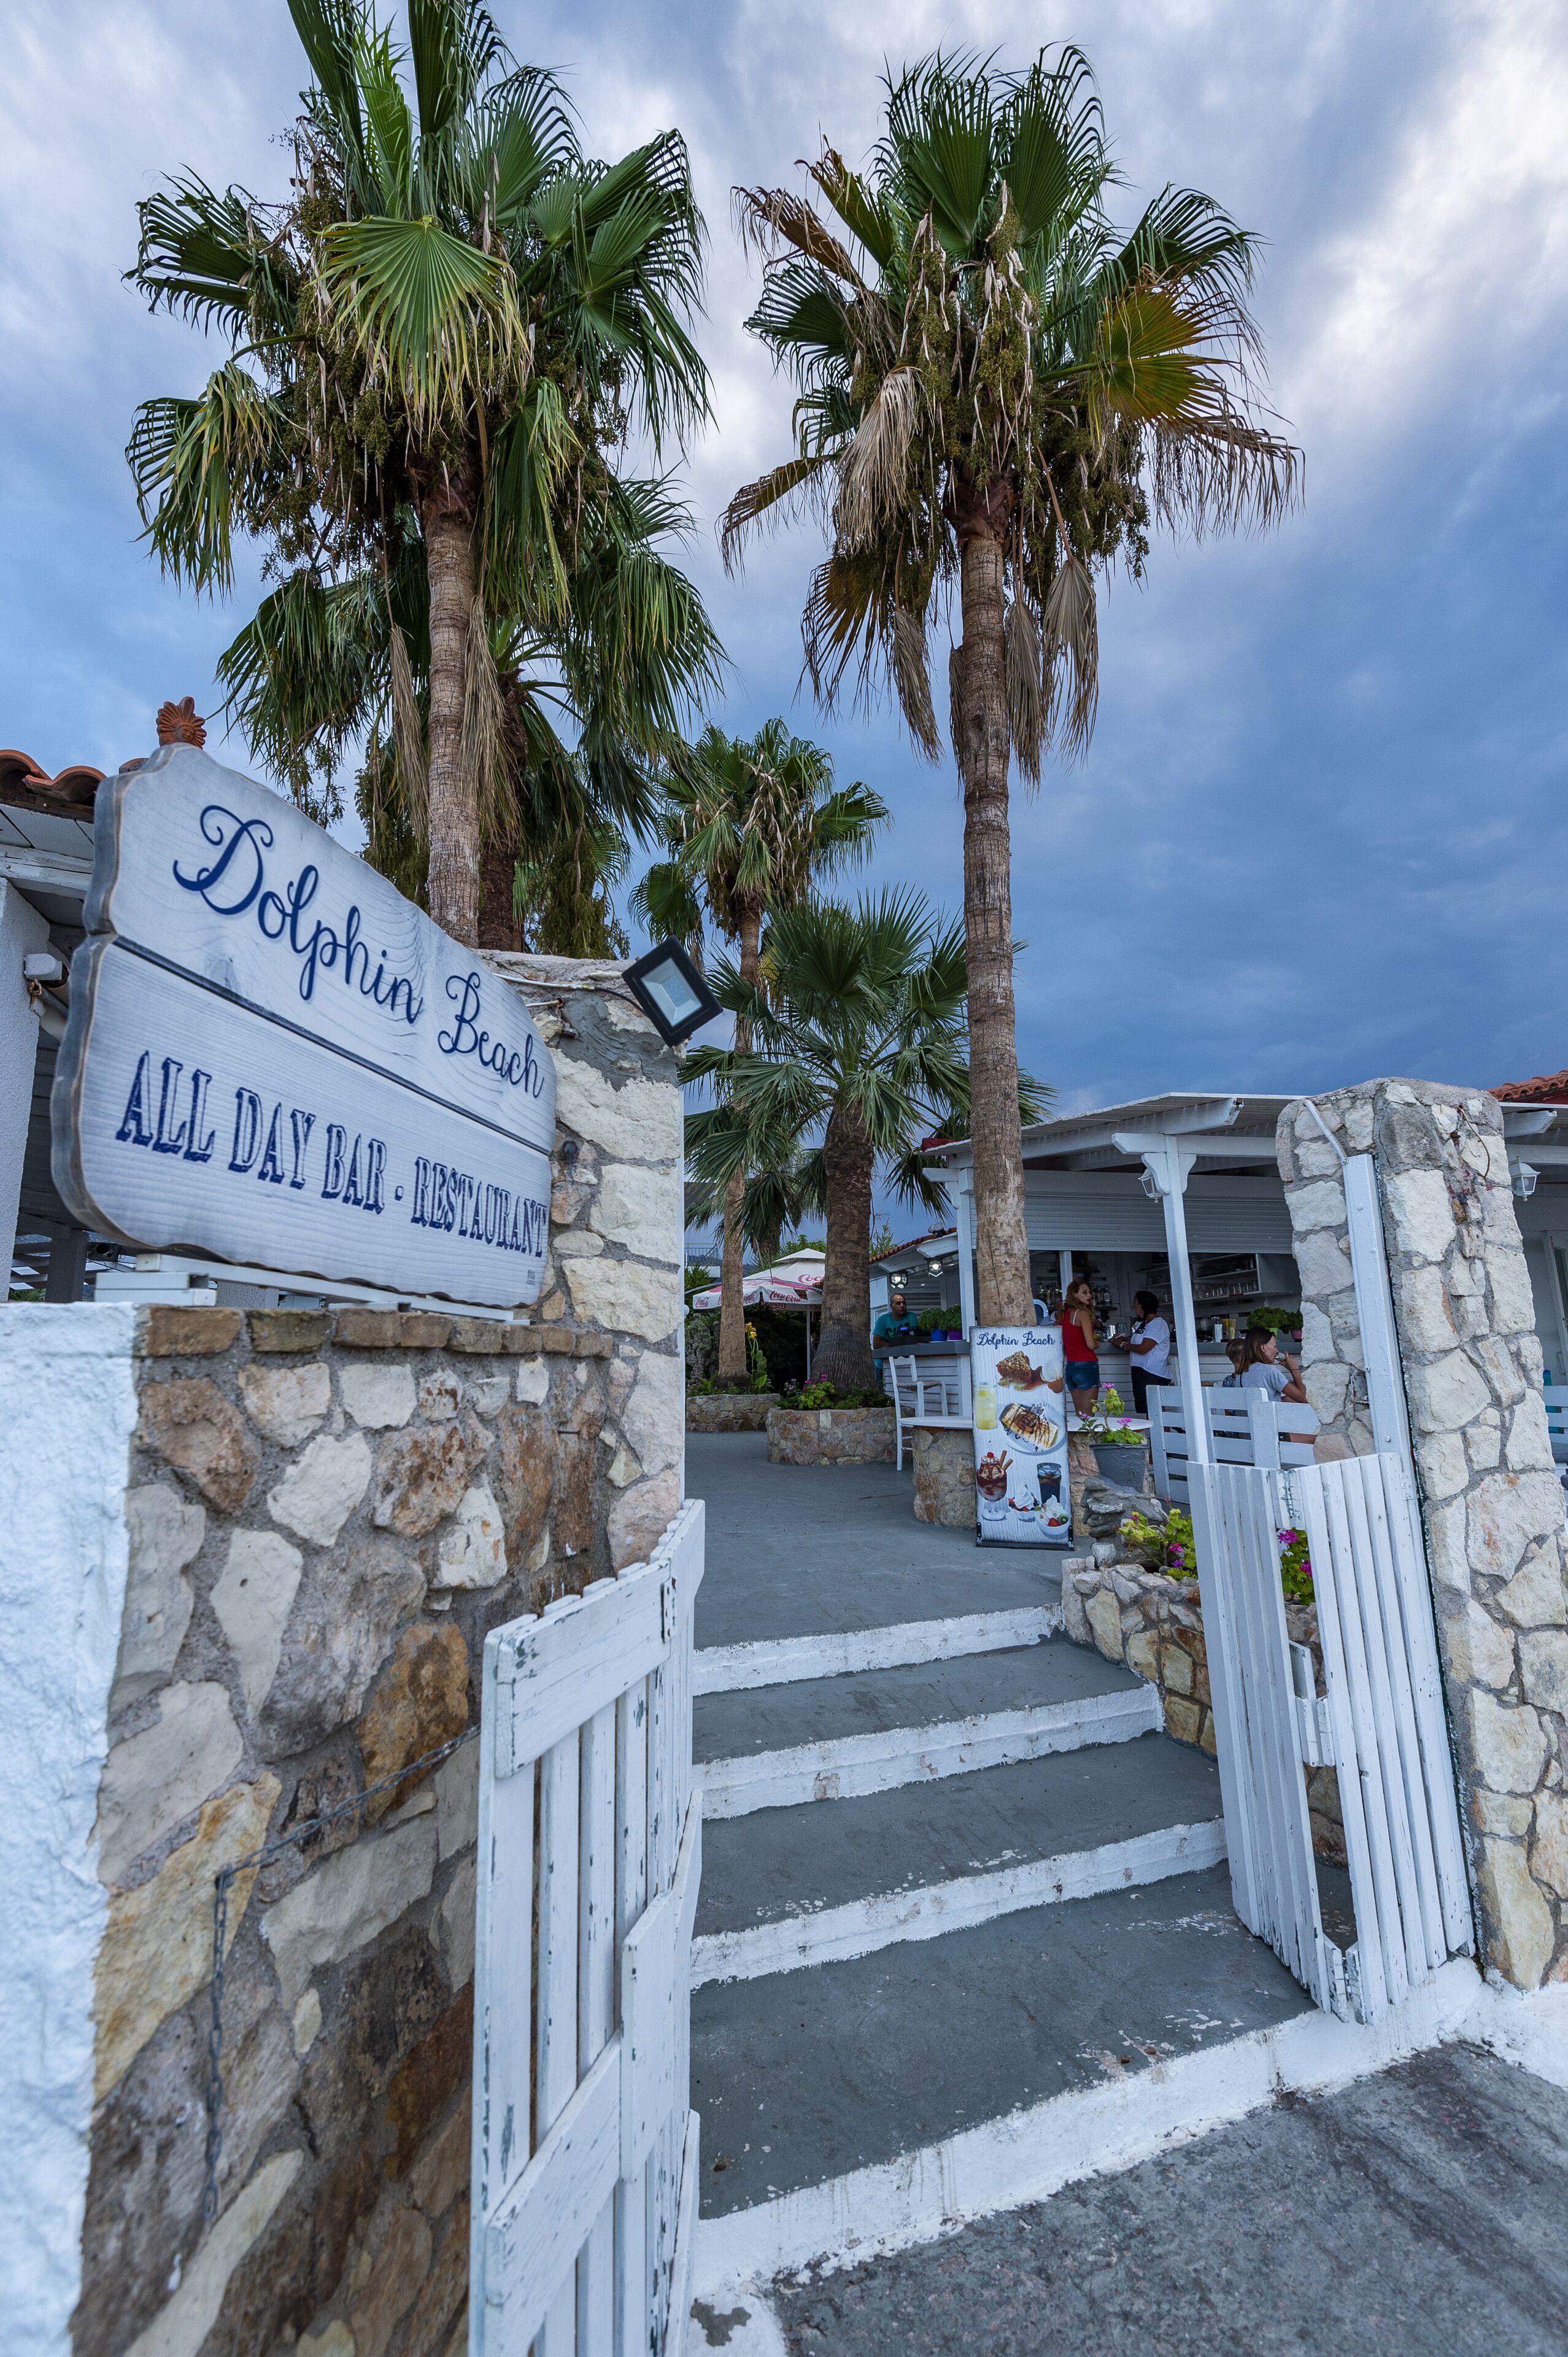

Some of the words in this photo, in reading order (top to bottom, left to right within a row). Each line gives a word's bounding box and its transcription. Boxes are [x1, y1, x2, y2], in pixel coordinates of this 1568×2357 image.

[172, 805, 424, 1024] Dolphin
[438, 972, 545, 1099] Beach
[115, 1050, 215, 1163] ALL
[228, 1086, 316, 1190] DAY
[321, 1123, 387, 1215] BAR
[411, 1156, 547, 1258] RESTAURANT
[976, 1332, 1018, 1350] Dolphin
[1022, 1330, 1055, 1346] Beach
